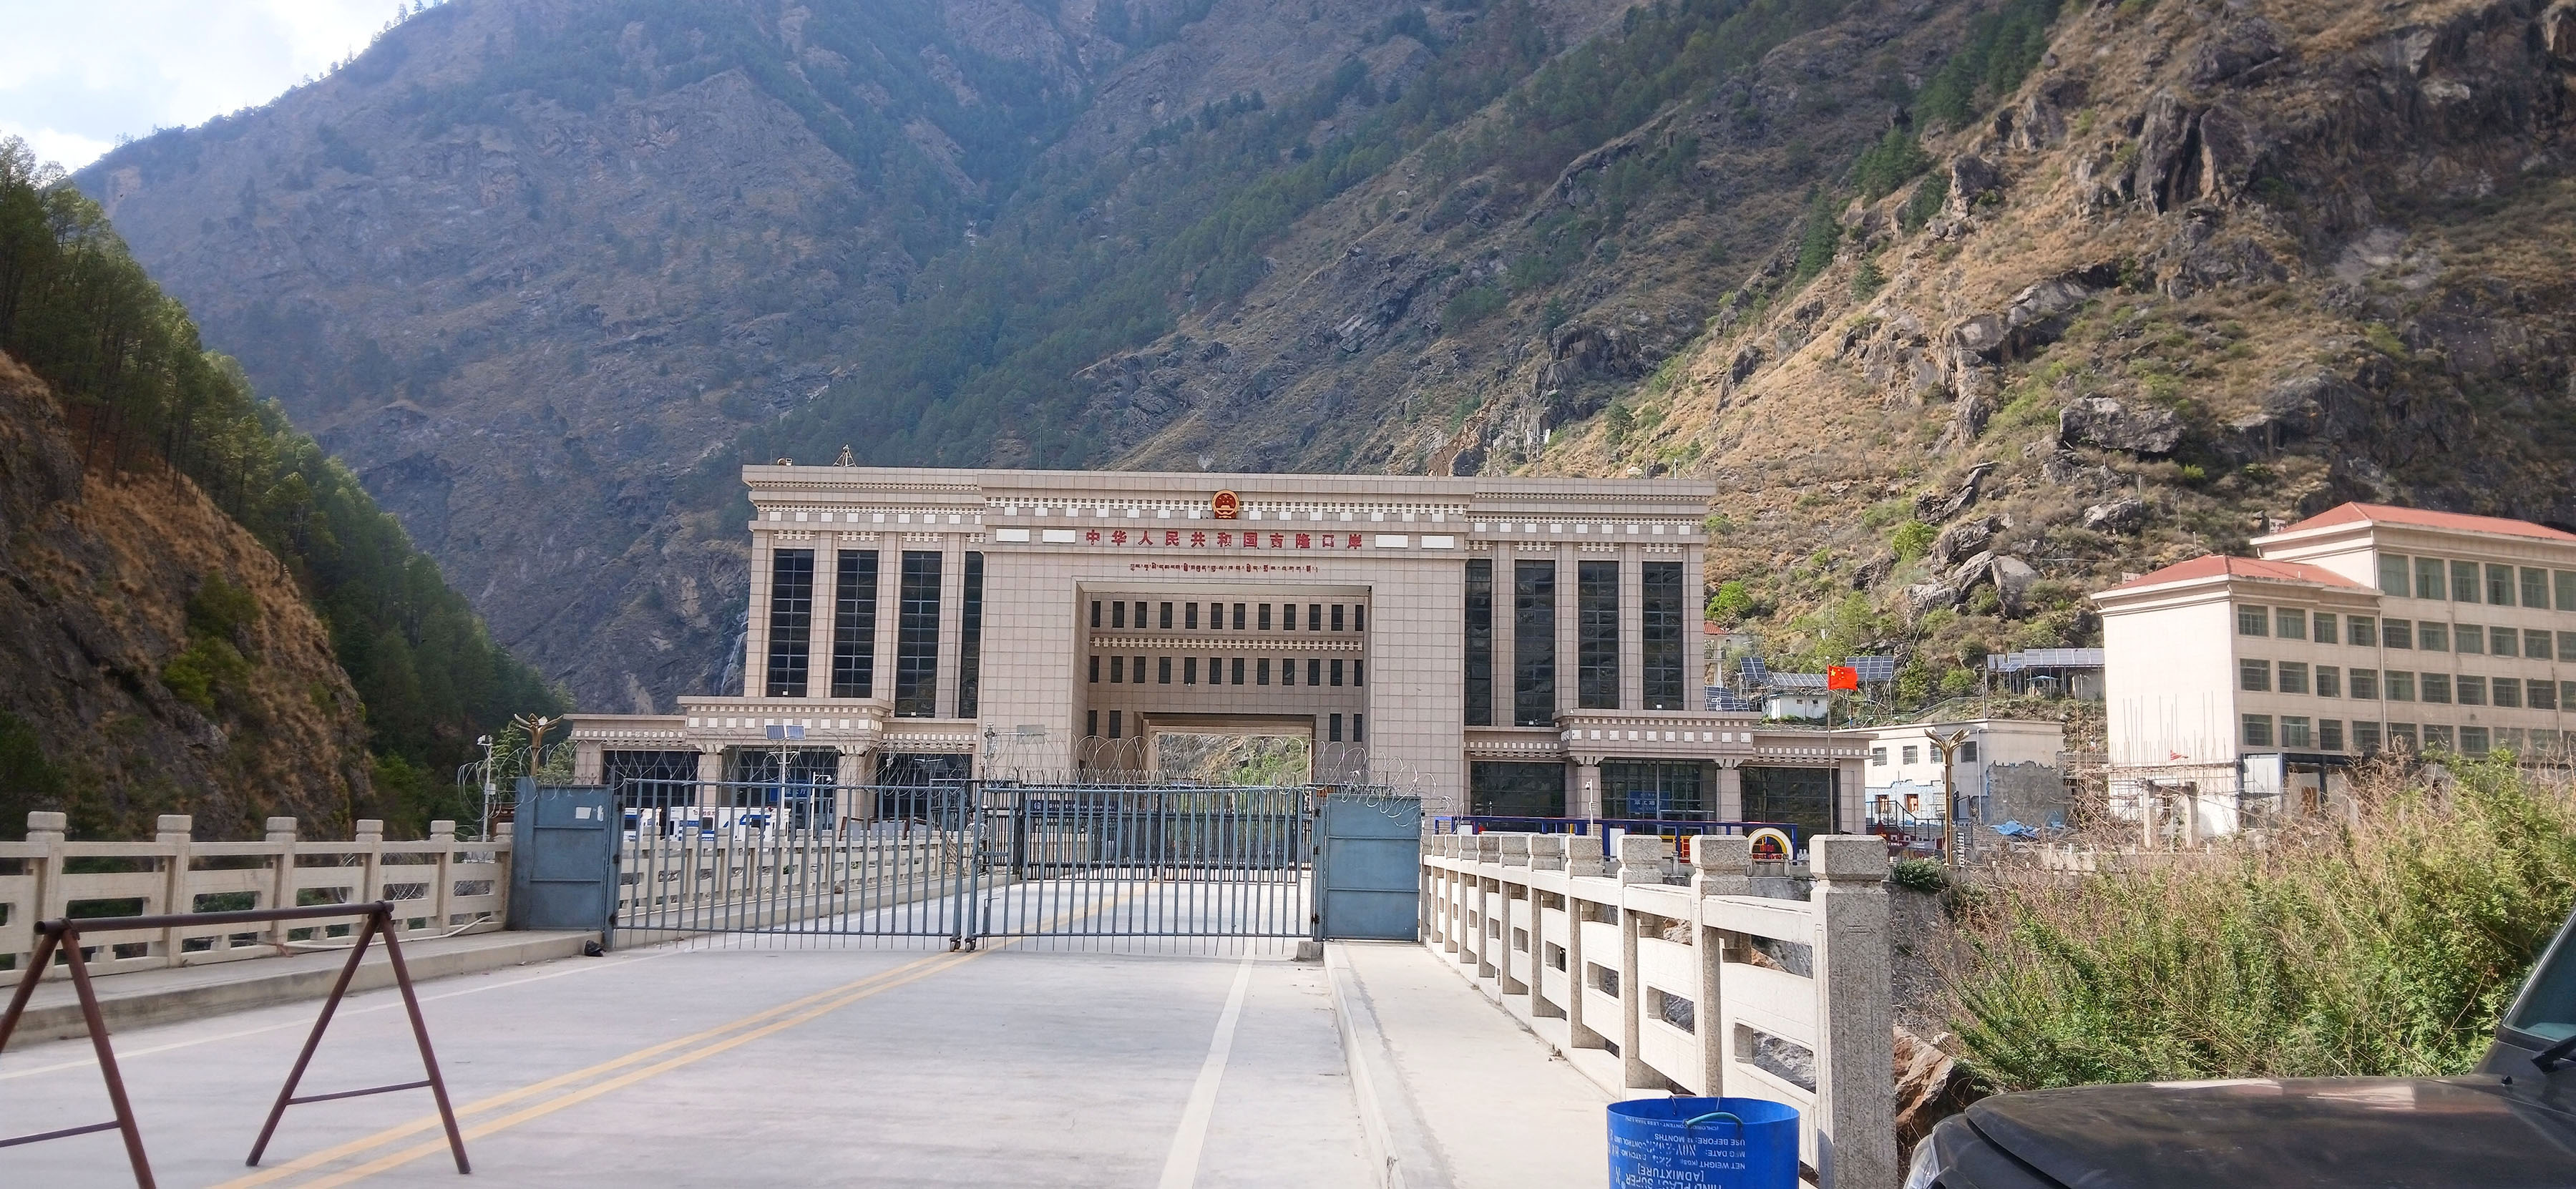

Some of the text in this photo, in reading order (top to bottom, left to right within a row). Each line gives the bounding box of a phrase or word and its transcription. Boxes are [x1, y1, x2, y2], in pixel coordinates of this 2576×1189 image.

[1085, 529, 1362, 549] 中华人民共和国吉隆口岸
[1654, 1133, 1685, 1143] MONTHS
[1695, 1137, 1729, 1145] BEFORE:
[1705, 1149, 1727, 1158] DATE:
[1699, 1160, 1729, 1169] WEIGHT
[1637, 1163, 1704, 1182] [ADMIXTURE]
